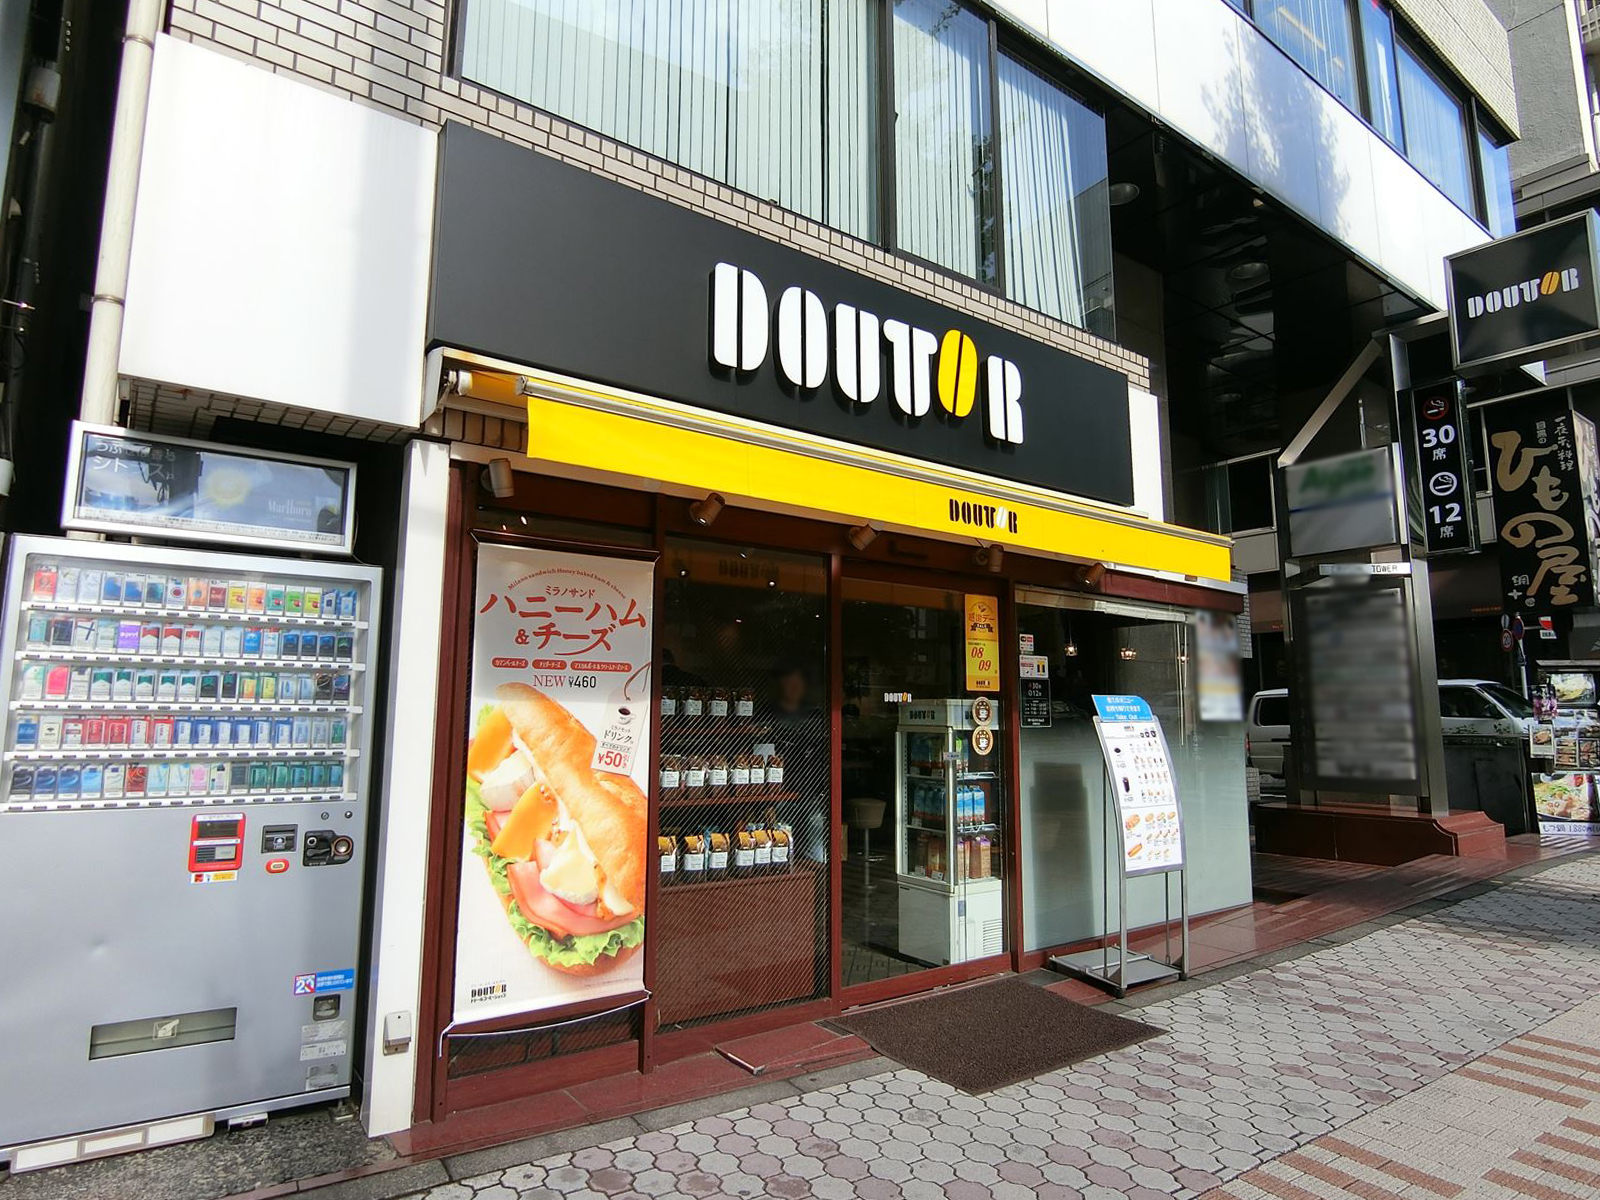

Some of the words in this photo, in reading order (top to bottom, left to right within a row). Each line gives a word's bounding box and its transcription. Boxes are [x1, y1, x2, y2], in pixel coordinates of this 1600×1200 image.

[1467, 267, 1580, 319] DOUTOR
[714, 261, 1024, 444] DOUTOR
[1421, 424, 1456, 448] 30
[1432, 447, 1447, 461] 席
[949, 498, 1018, 533] DOUTOR
[1429, 503, 1462, 524] 12
[1490, 430, 1587, 606] ひもの屋
[1440, 525, 1454, 539] 席
[1372, 565, 1398, 573] TOWER
[545, 585, 595, 599] ミラノサンド
[480, 593, 646, 628] ハニーハム
[533, 674, 567, 688] NEW
[568, 675, 597, 688] ¥460
[884, 692, 912, 703] DOUTOR
[598, 750, 622, 767] ¥50
[471, 984, 507, 998] DOUTOR
